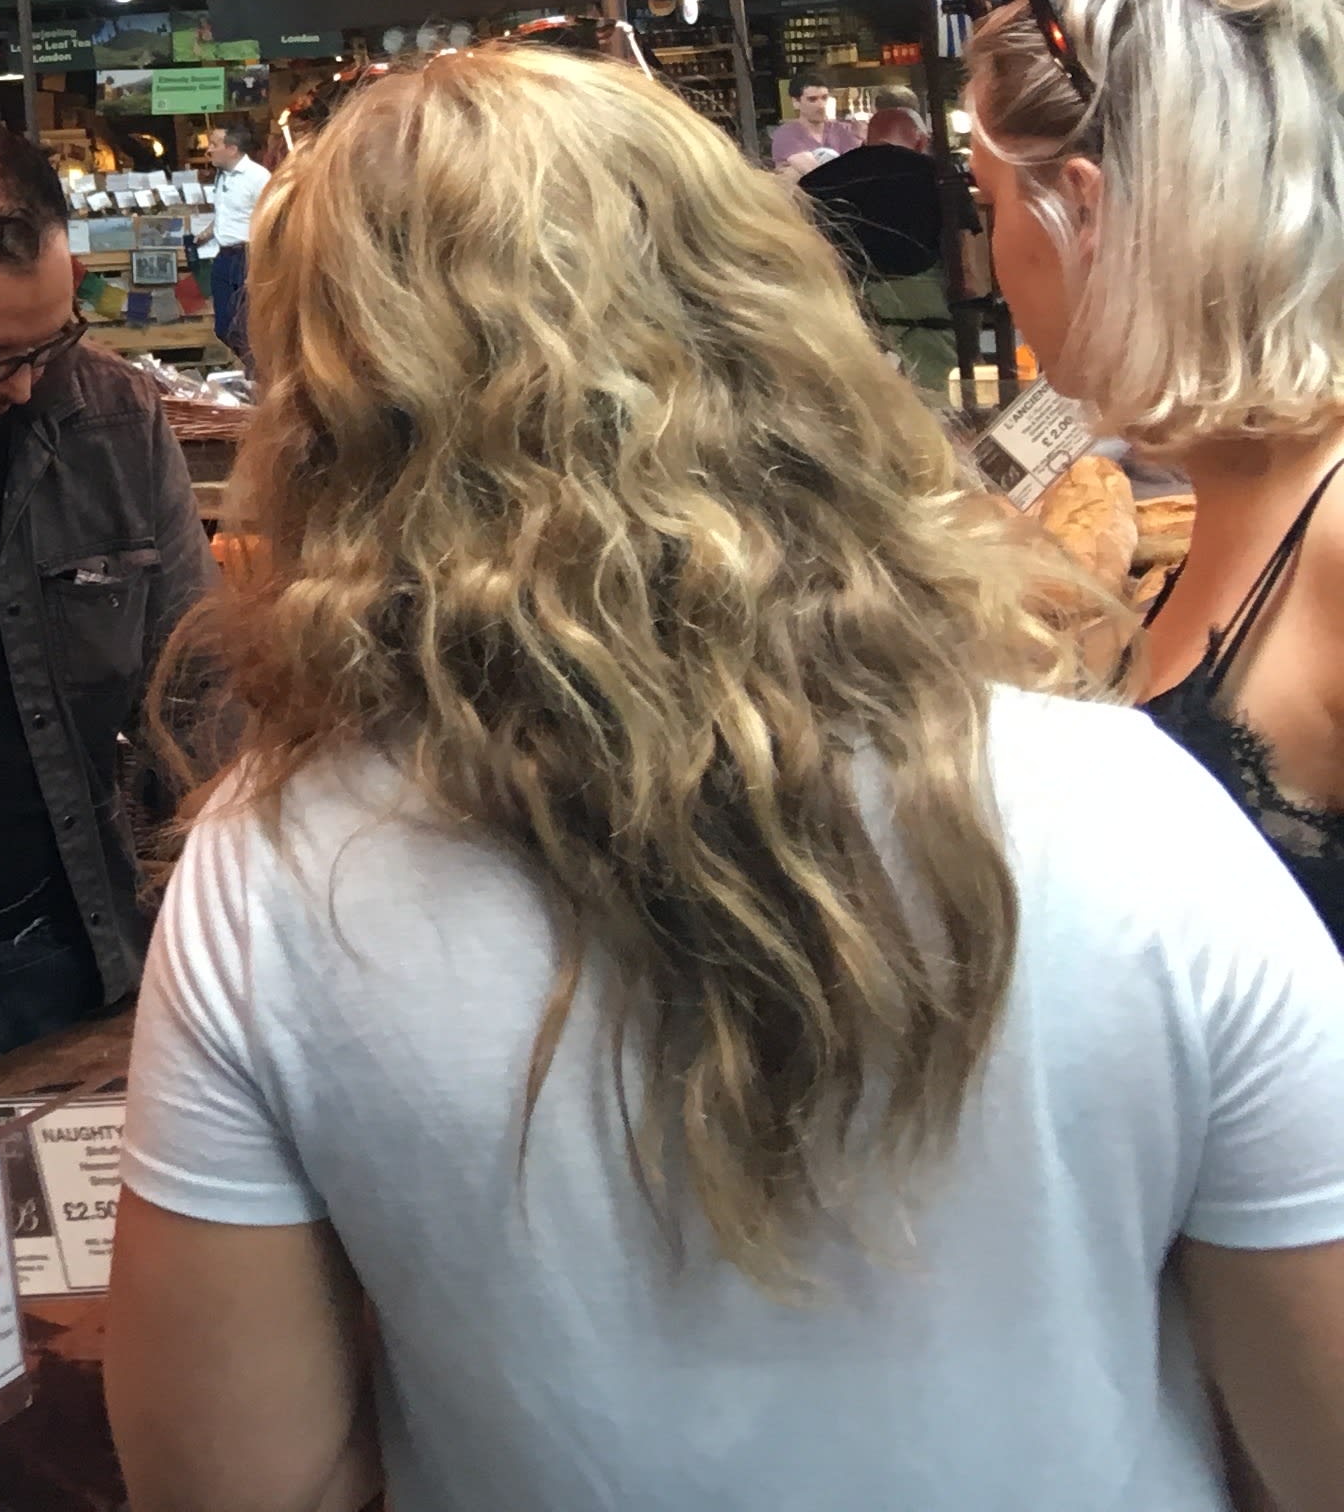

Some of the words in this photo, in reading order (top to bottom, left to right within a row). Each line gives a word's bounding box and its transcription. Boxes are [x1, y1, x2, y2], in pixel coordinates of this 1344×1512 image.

[71, 38, 91, 48] Tea
[32, 52, 72, 64] London
[41, 1124, 124, 1143] NAUGHTY
